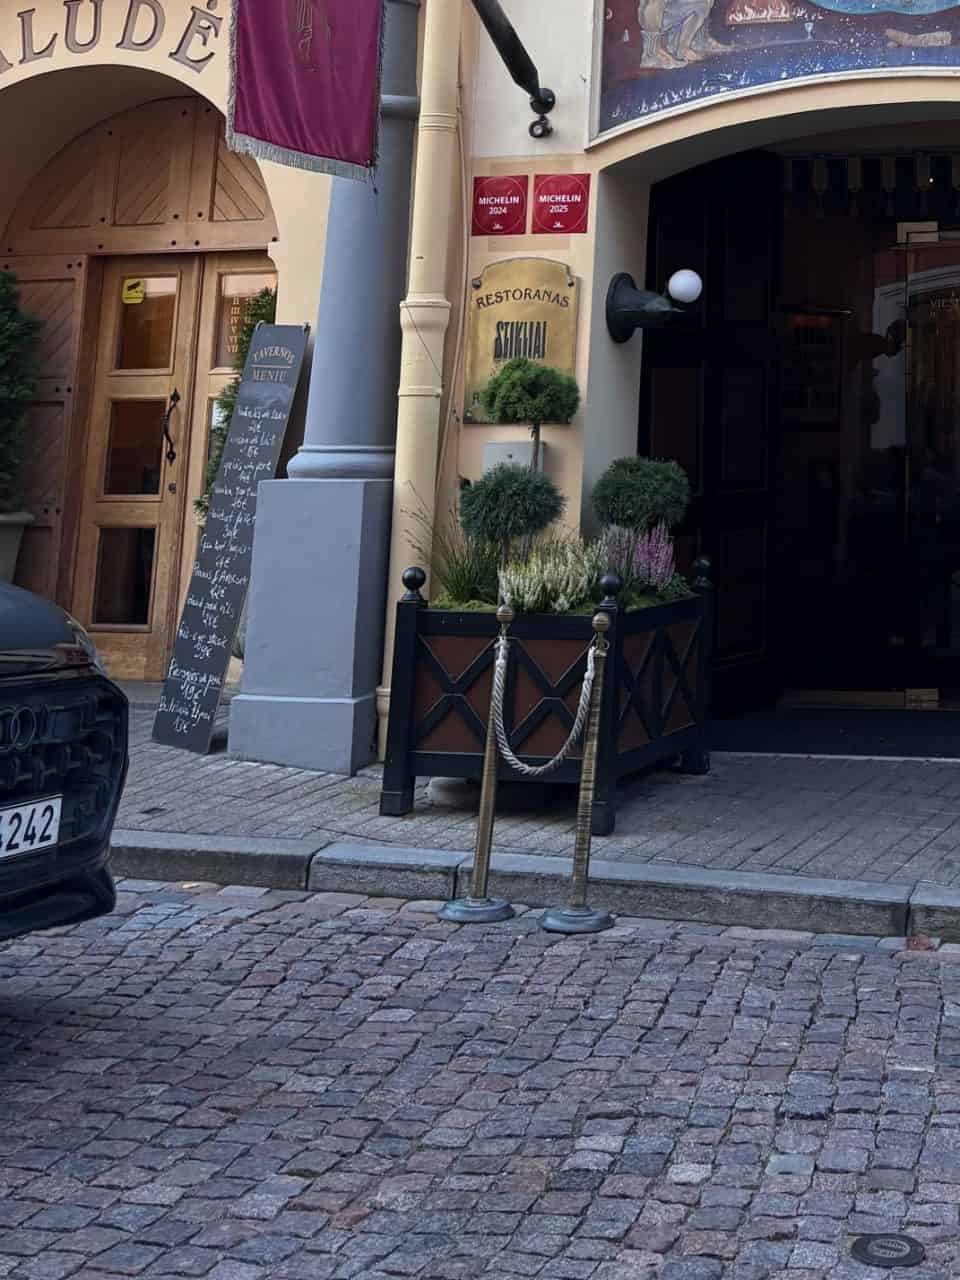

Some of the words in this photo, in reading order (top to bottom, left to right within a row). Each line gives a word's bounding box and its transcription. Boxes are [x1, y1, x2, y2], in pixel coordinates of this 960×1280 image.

[478, 196, 520, 205] MICHELIN
[539, 194, 582, 203] MICHELIN
[489, 206, 508, 215] 2024
[549, 204, 569, 214] 2025
[476, 287, 570, 309] RESTORANAS
[0, 804, 54, 851] 242
